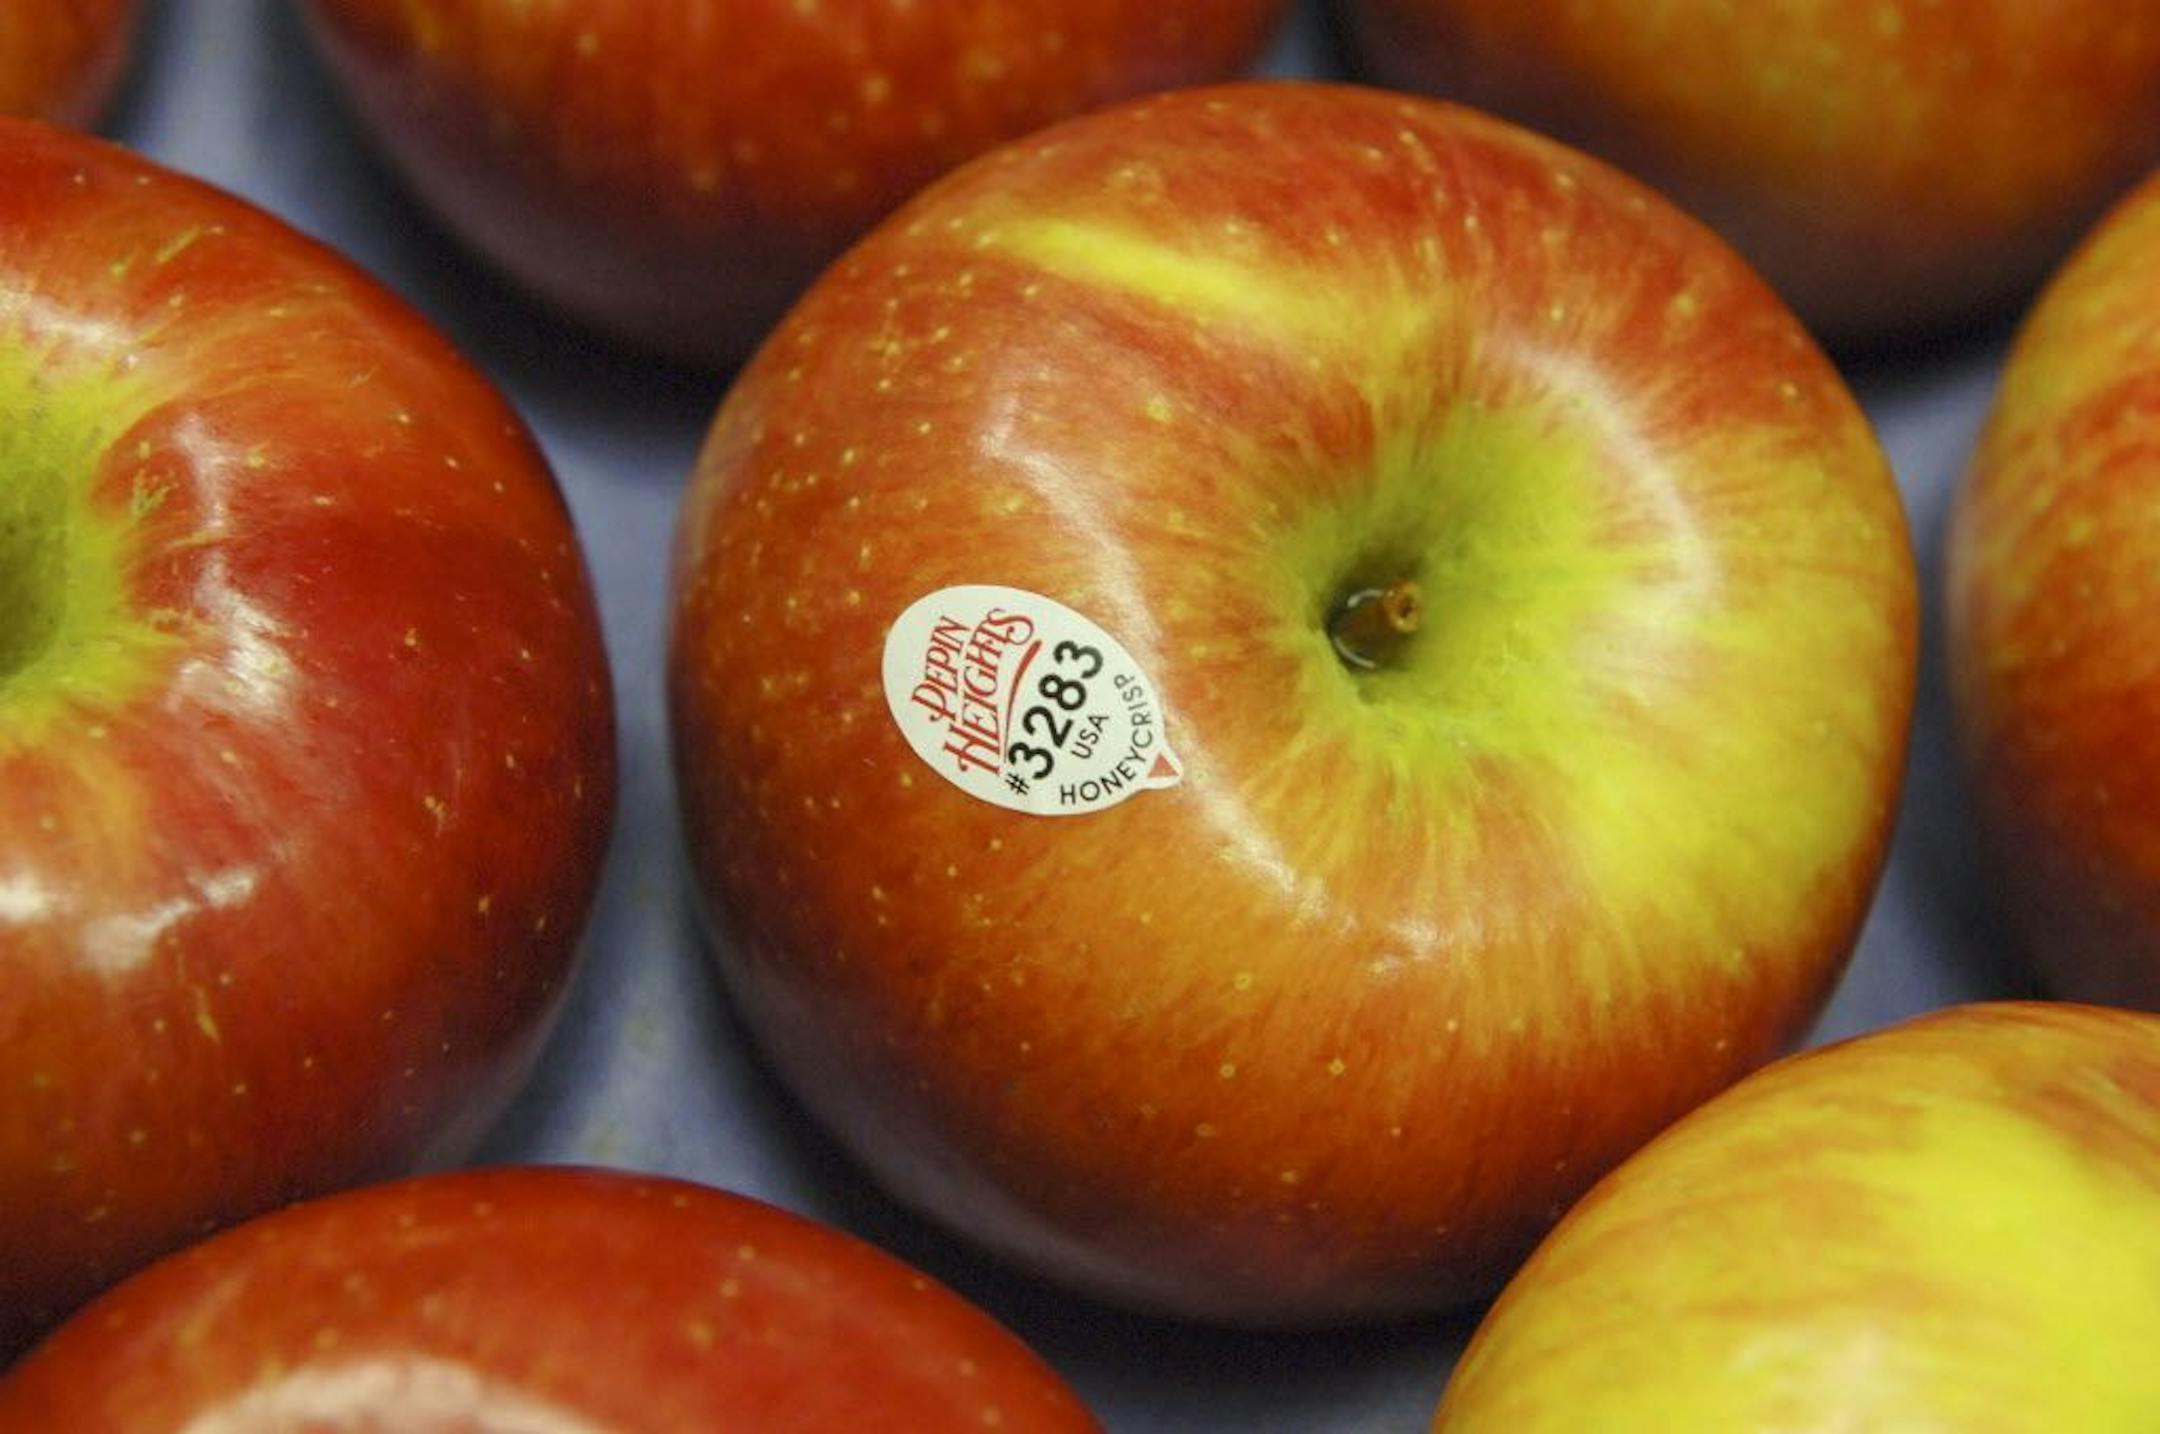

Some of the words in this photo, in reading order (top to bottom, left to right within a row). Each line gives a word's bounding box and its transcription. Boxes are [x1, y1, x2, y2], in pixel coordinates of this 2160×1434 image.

[911, 615, 970, 722] PEPIN
[943, 608, 1035, 776] HEIGHTS
[1005, 640, 1104, 796] #3283
[1060, 673, 1153, 805] HONEYCRISP
[1071, 712, 1110, 760] USA
